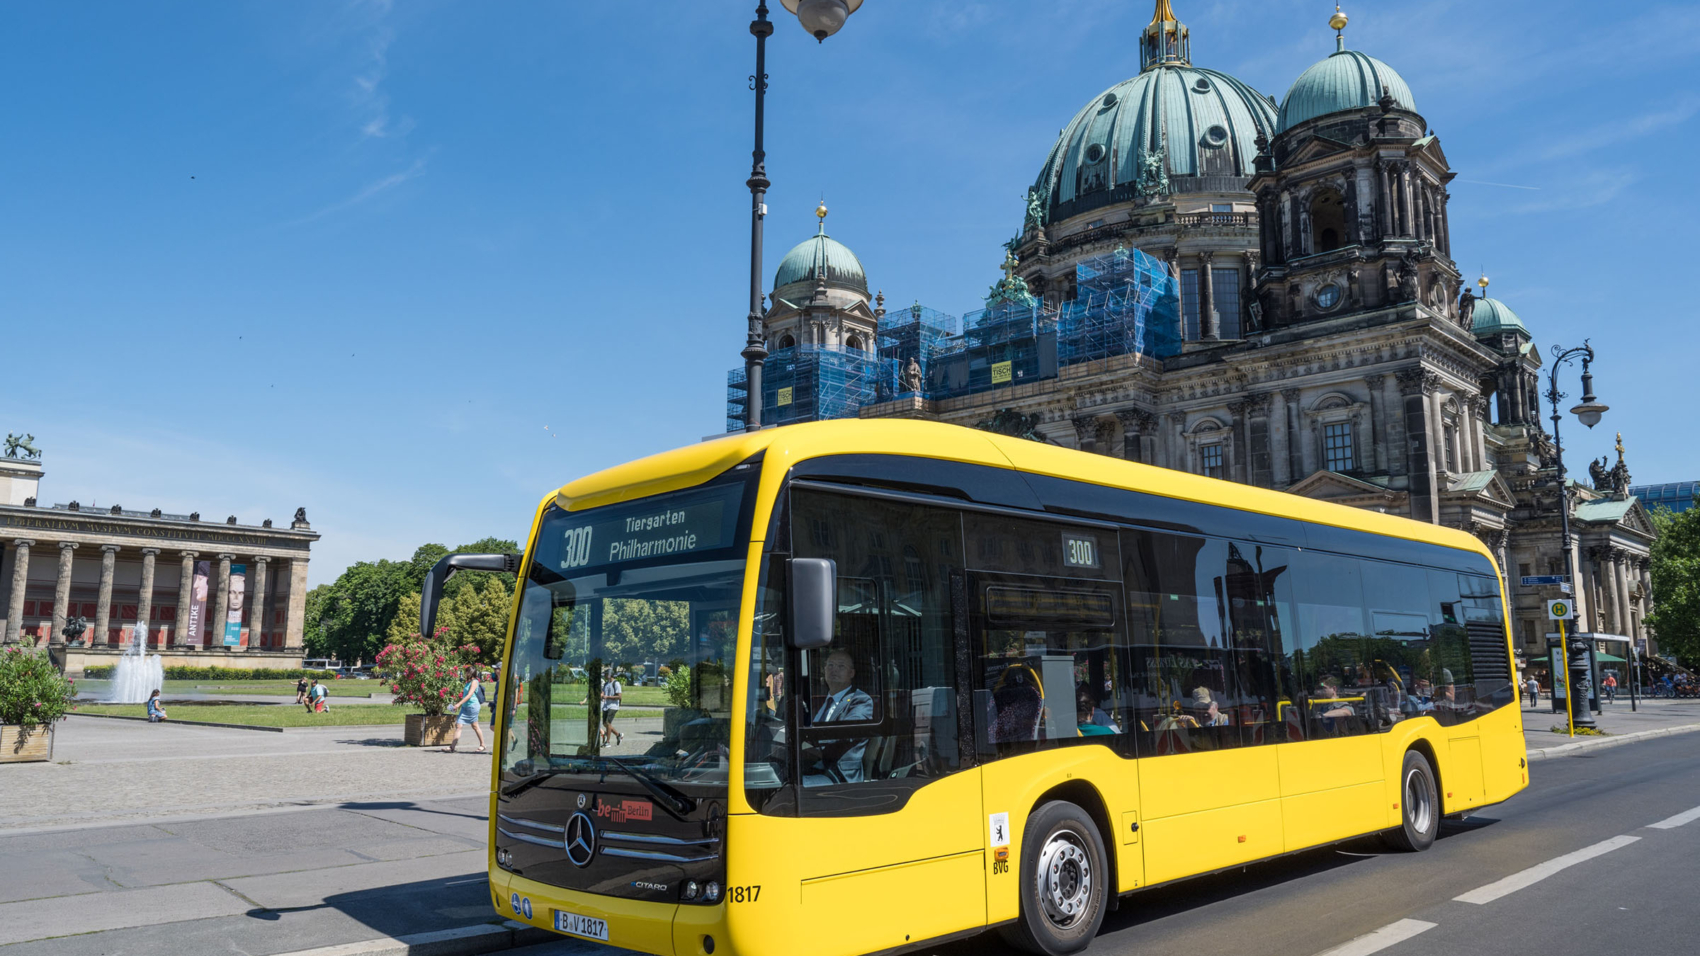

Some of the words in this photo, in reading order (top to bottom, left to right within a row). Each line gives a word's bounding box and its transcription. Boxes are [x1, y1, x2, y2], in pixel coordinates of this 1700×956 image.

[992, 367, 1011, 376] TISCH
[626, 510, 686, 533] Tiergarten
[136, 527, 202, 539] CONSTITVIT
[561, 525, 593, 569] 300
[609, 530, 697, 561] Philharmonie
[1068, 539, 1092, 565] 300
[1555, 605, 1563, 614] H
[188, 605, 199, 636] ANTIKE
[597, 798, 611, 817] be
[627, 805, 649, 817] Berlin
[993, 860, 1009, 875] BVG
[727, 885, 761, 903] 1817
[562, 913, 568, 929] B
[573, 916, 580, 932] V
[581, 917, 604, 937] 1817
